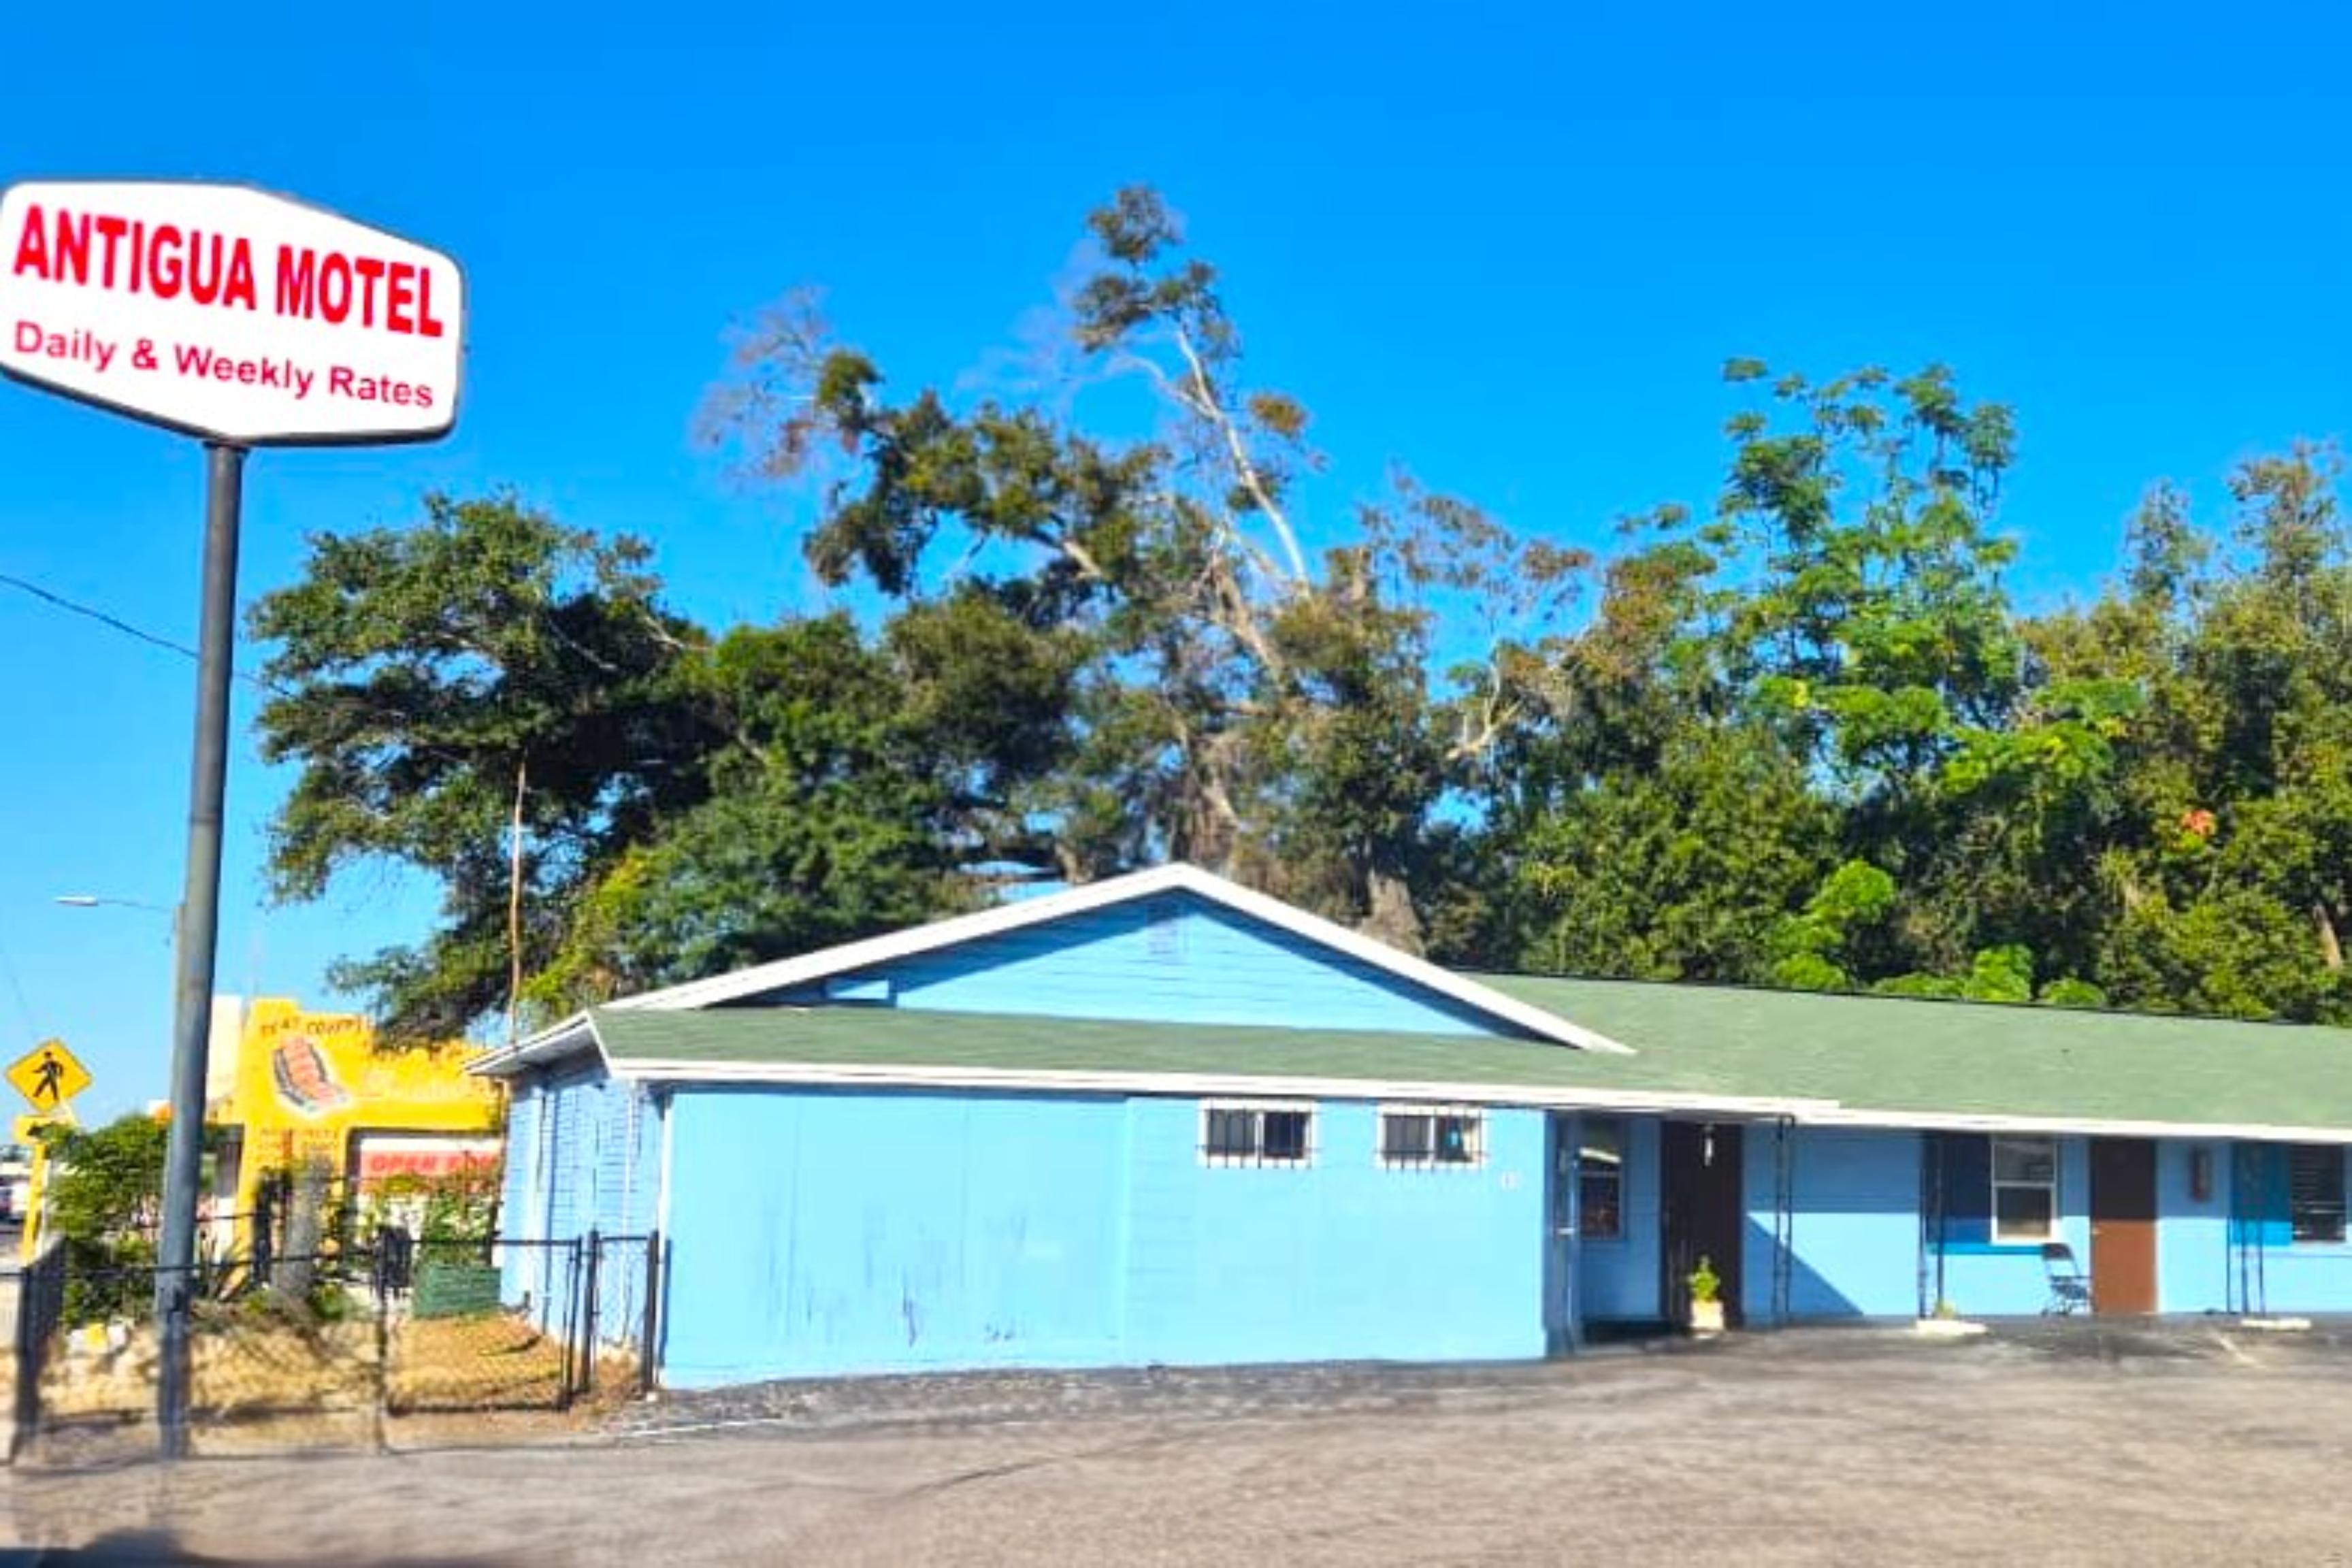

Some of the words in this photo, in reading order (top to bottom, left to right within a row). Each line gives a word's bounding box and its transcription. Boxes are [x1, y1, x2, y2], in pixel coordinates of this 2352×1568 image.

[12, 203, 258, 311] ANTIGUA
[274, 243, 444, 338] MOTEL
[14, 320, 116, 372] Daily
[131, 339, 159, 371] &
[174, 344, 314, 400] Weekly
[328, 366, 434, 408] Rates
